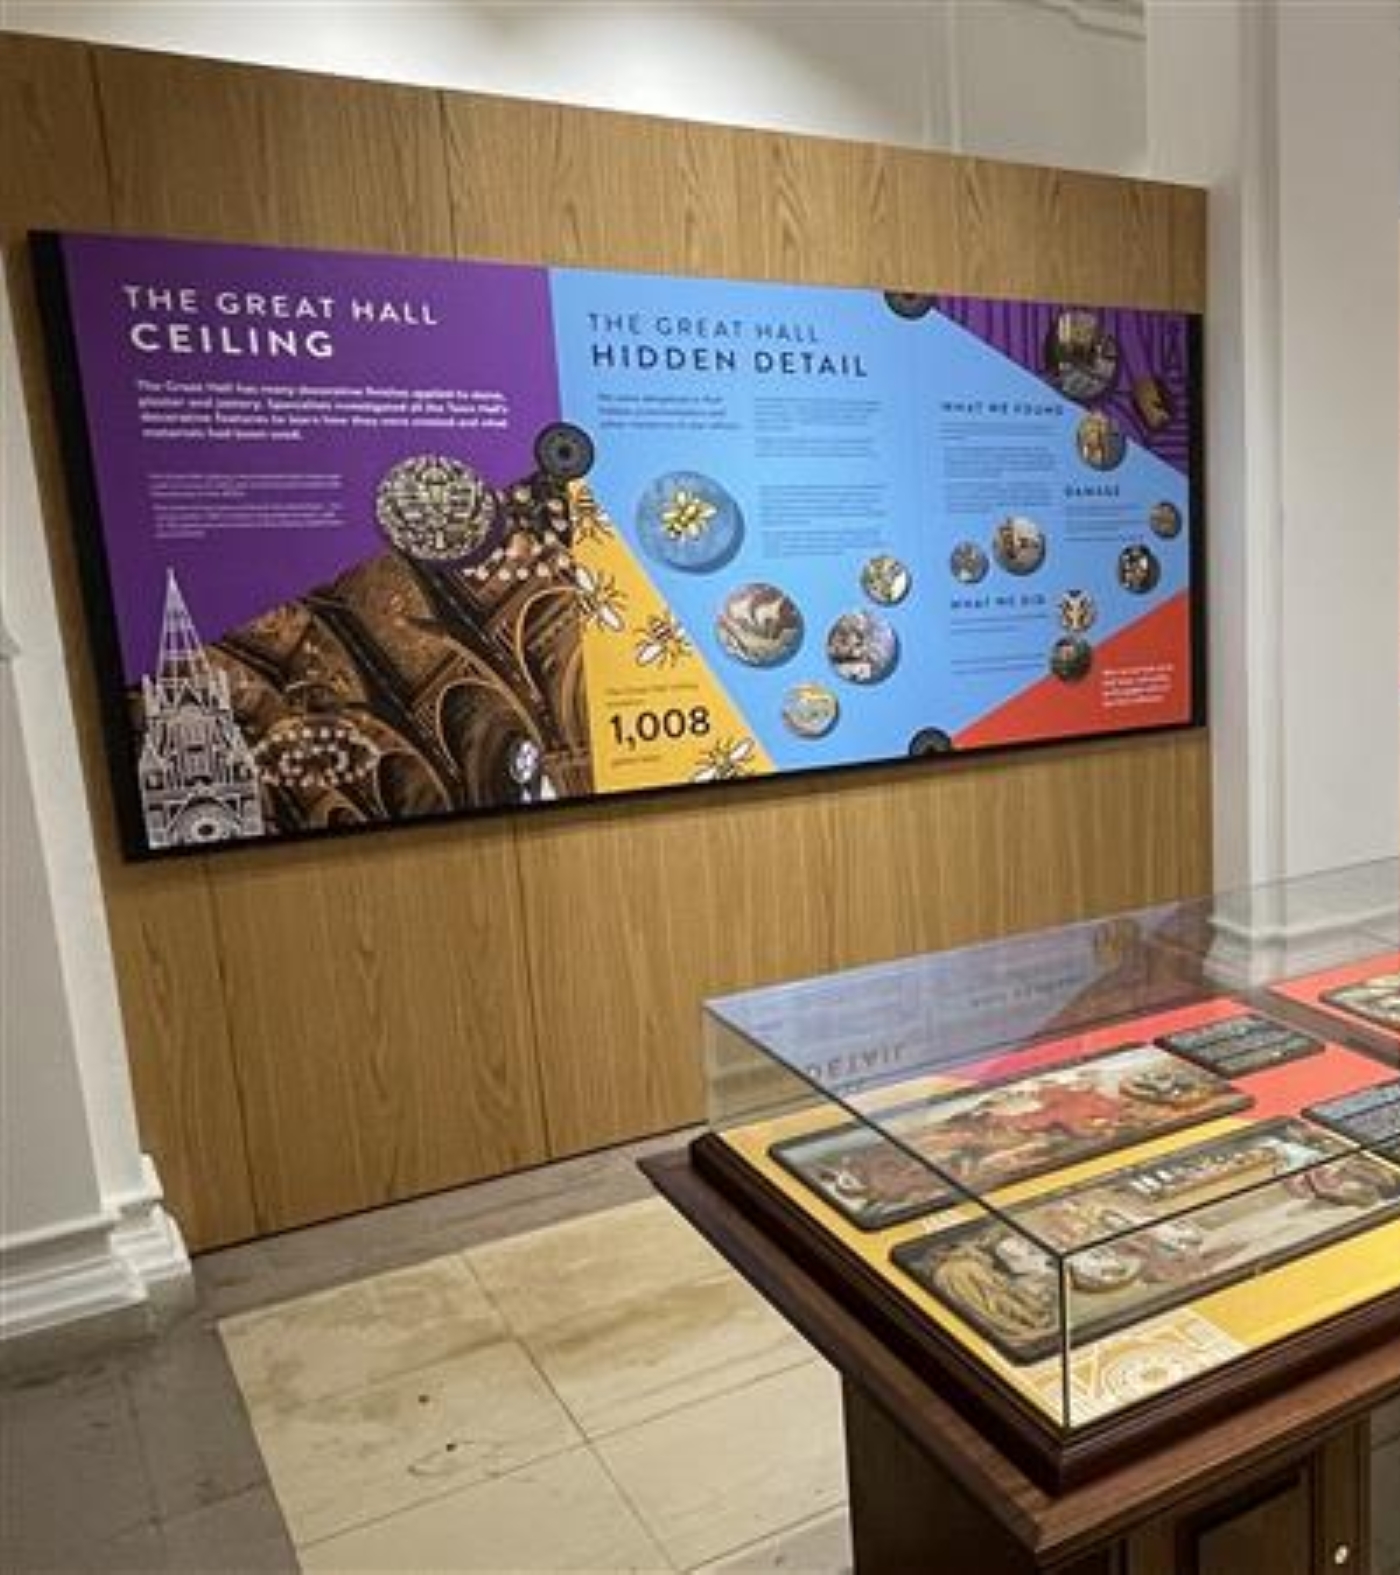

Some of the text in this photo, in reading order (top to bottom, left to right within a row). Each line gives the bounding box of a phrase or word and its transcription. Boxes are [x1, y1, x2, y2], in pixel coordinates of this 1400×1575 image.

[124, 285, 438, 325] THE GREAT HALL
[130, 323, 335, 358] CEILING
[588, 312, 818, 343] THE GREAT HALL
[591, 345, 868, 377] HIDDEN DETAIL
[138, 379, 161, 392] The
[205, 381, 234, 393] Hall
[942, 400, 1064, 417] WHAT WE FOUND
[1064, 484, 1120, 498] DAMAGE
[950, 593, 990, 610] WHAT
[996, 594, 1015, 609] WE
[608, 704, 710, 751] 1,008
